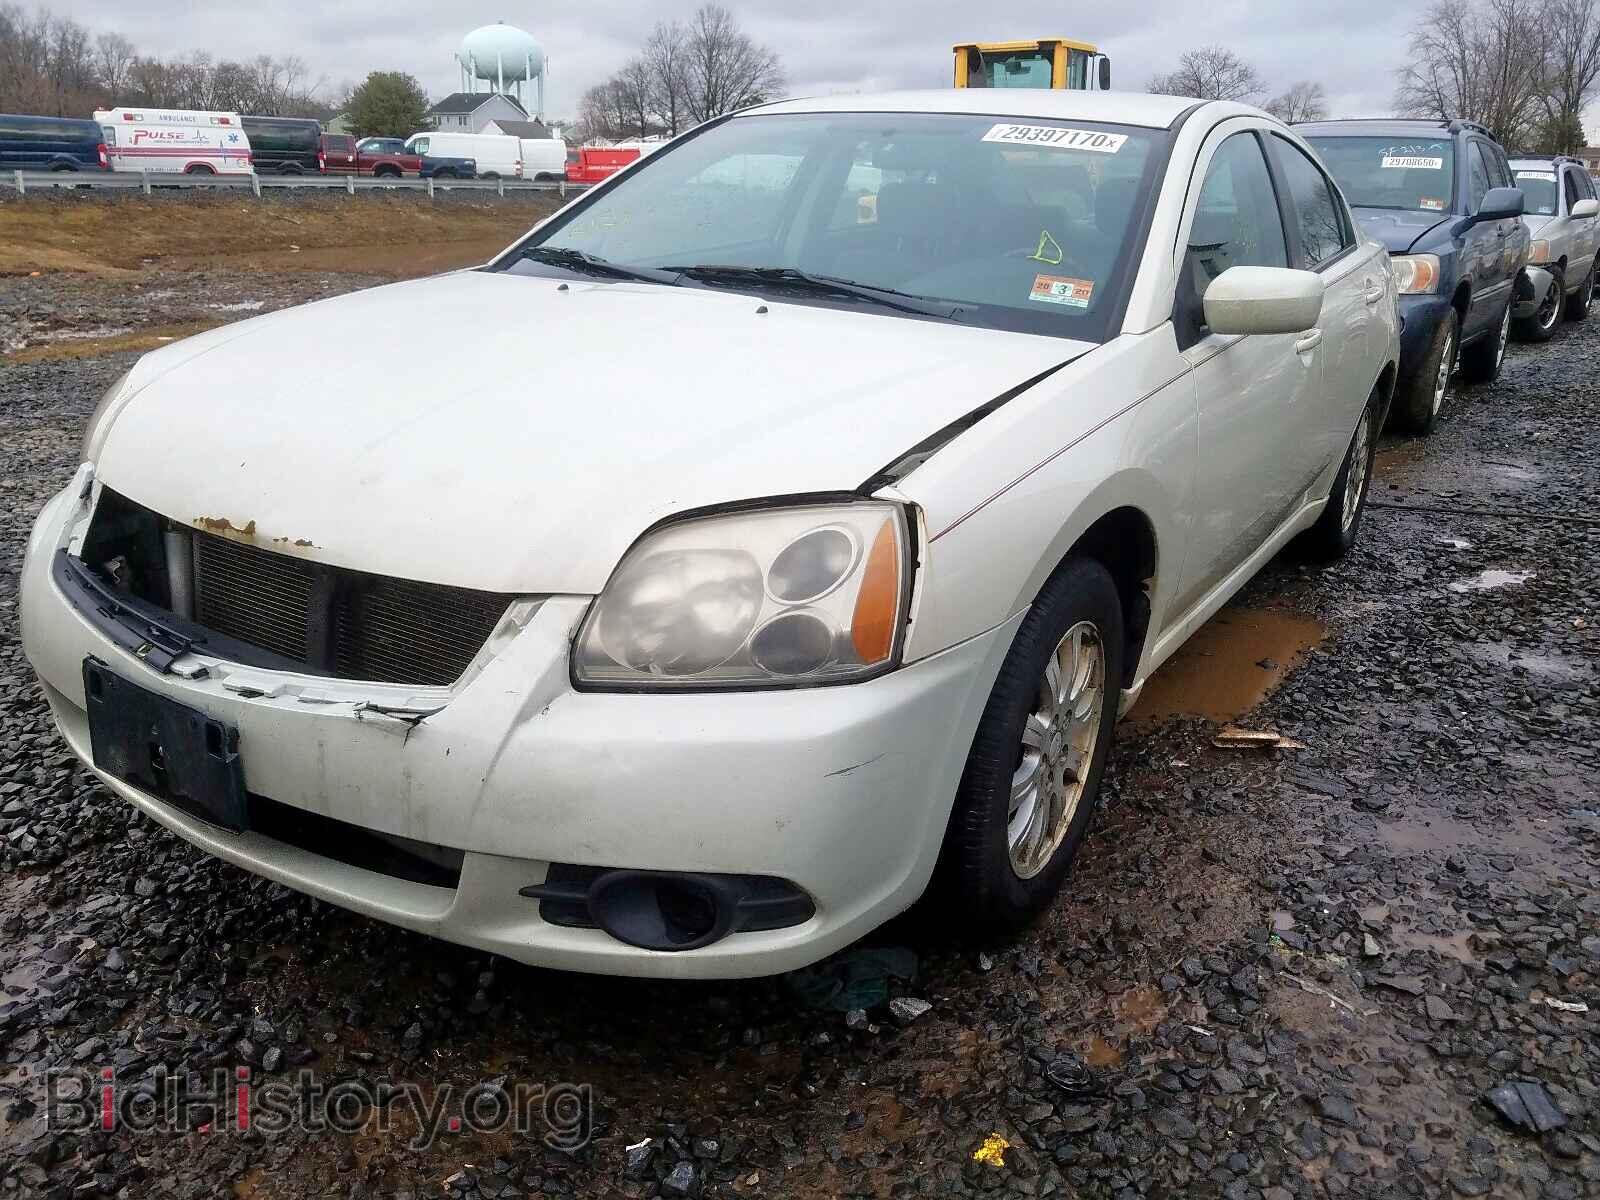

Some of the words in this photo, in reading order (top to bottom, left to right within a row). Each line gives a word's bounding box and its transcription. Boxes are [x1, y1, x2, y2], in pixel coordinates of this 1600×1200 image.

[159, 114, 196, 122] AMBULANCE
[133, 130, 185, 145] PULSE
[1058, 284, 1068, 295] 3
